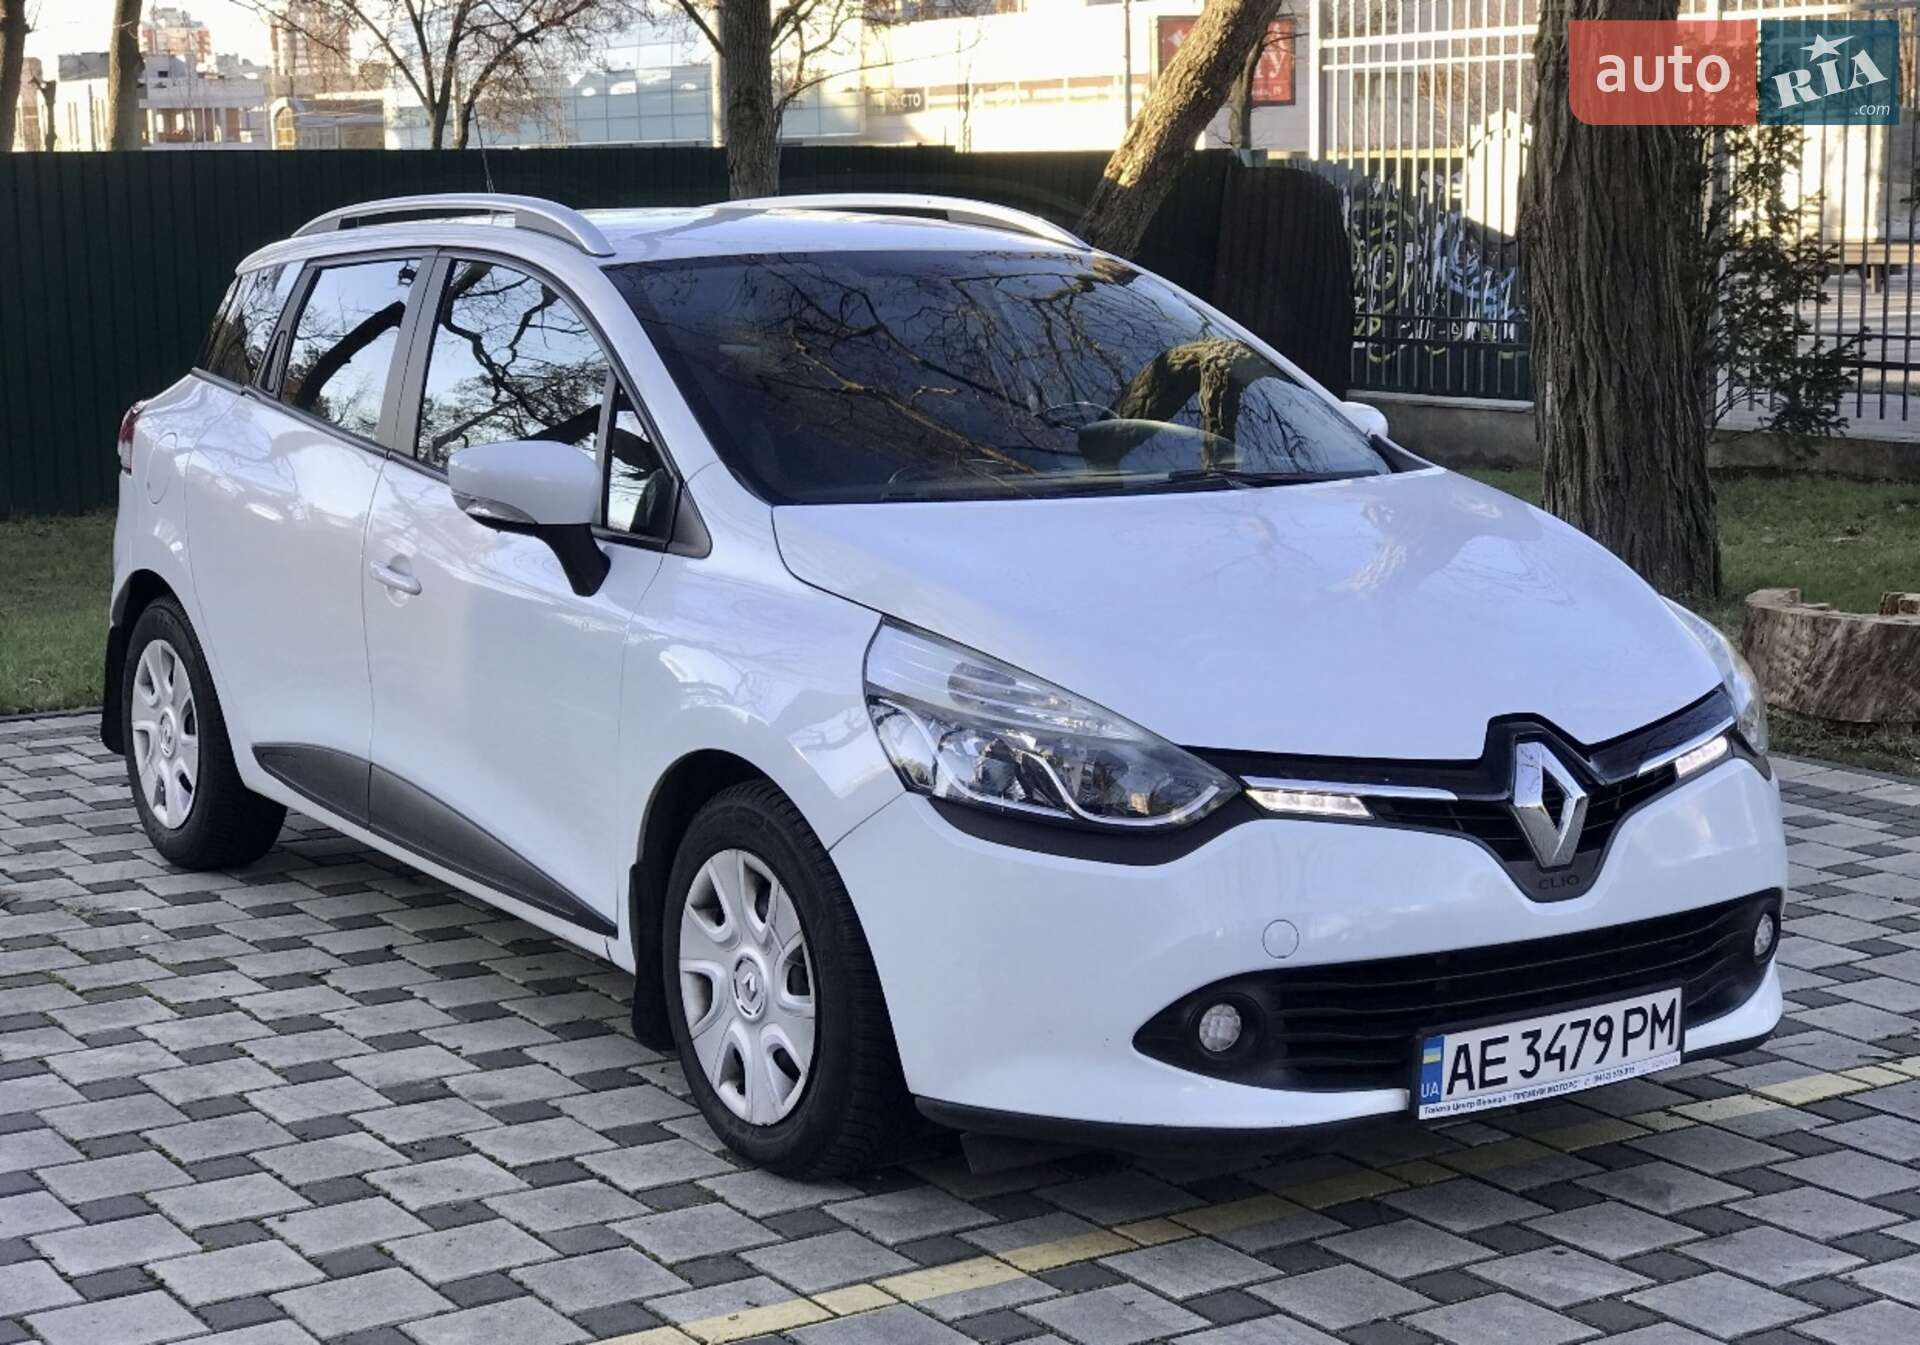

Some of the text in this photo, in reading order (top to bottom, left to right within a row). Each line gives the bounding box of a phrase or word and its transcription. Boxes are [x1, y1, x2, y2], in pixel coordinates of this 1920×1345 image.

[1538, 874, 1580, 890] CLIO
[1446, 998, 1677, 1095] AE 3479 PM
[1421, 1081, 1440, 1098] UA
